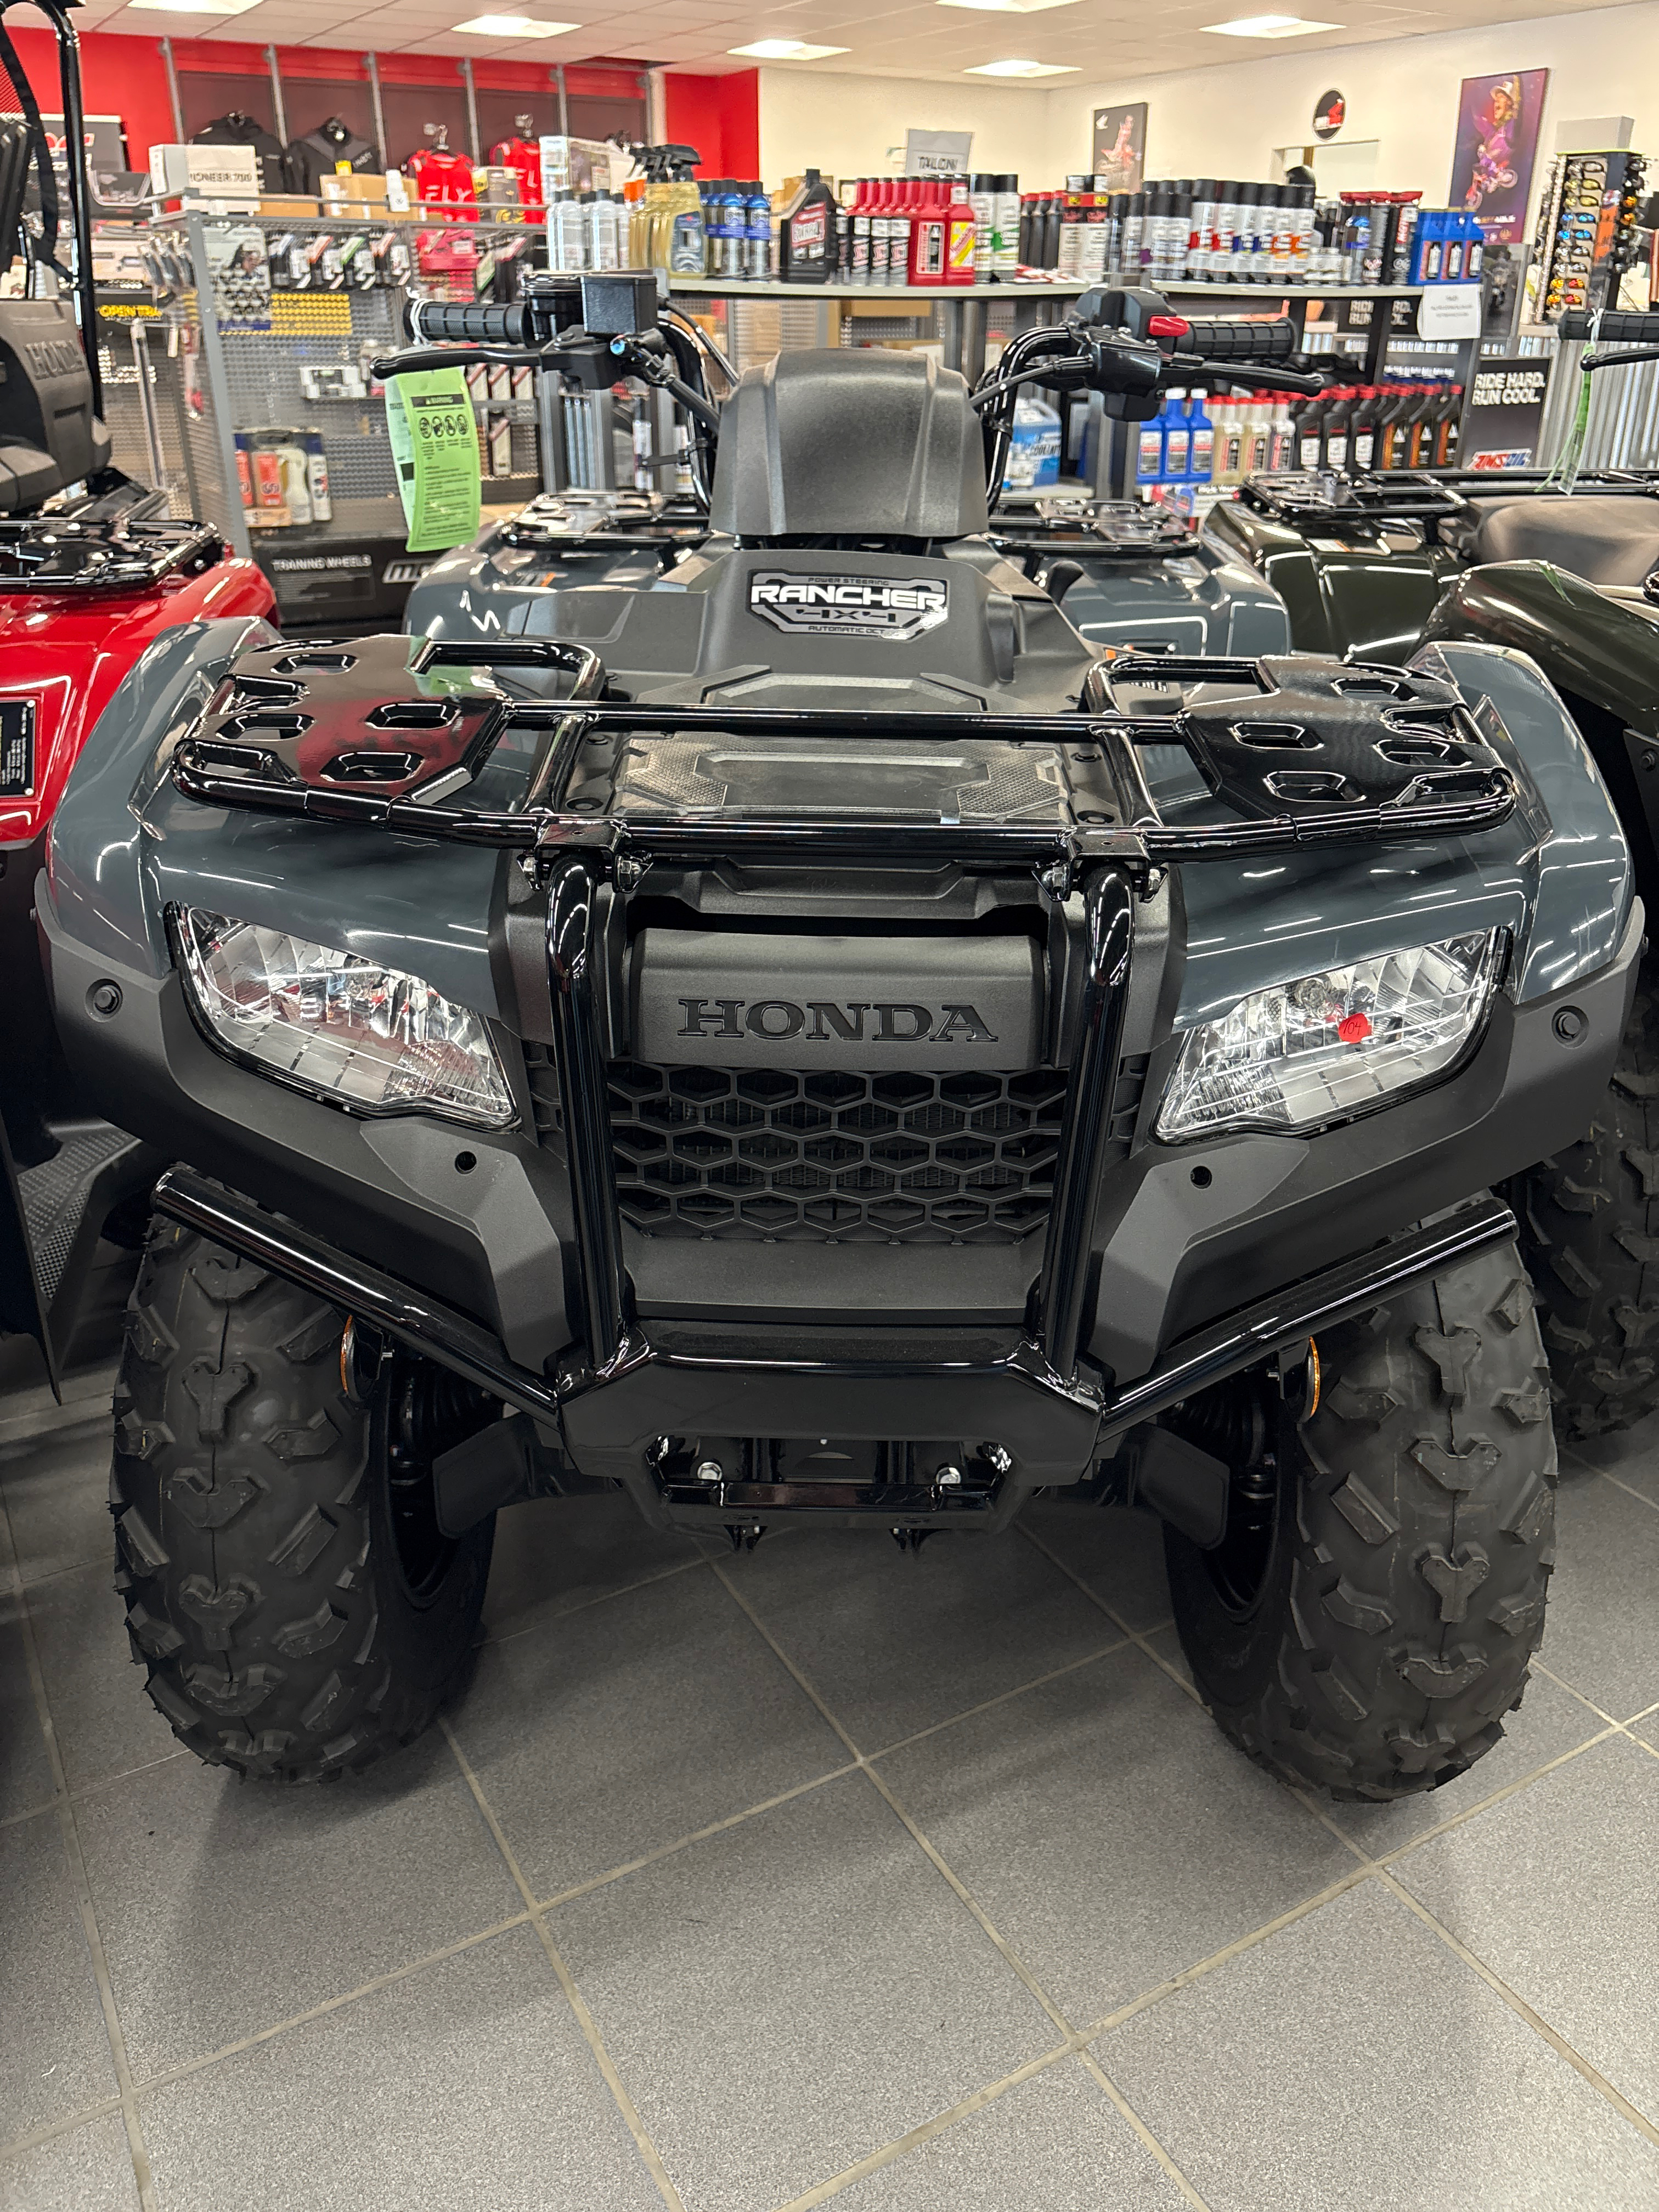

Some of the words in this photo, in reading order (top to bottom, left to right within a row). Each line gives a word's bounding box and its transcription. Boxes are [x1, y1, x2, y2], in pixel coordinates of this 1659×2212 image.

[917, 156, 959, 171] TALON
[189, 173, 230, 182] IONEER
[1474, 373, 1506, 389] RIDE
[1506, 371, 1545, 388] HARD.
[1471, 389, 1502, 406] RUN
[1502, 388, 1541, 404] COOL.
[271, 557, 325, 572] TRAINING
[326, 554, 372, 569] WHEELS
[751, 585, 946, 610] RANCHER
[678, 998, 999, 1042] HONDA
[1343, 1019, 1361, 1036] 104
